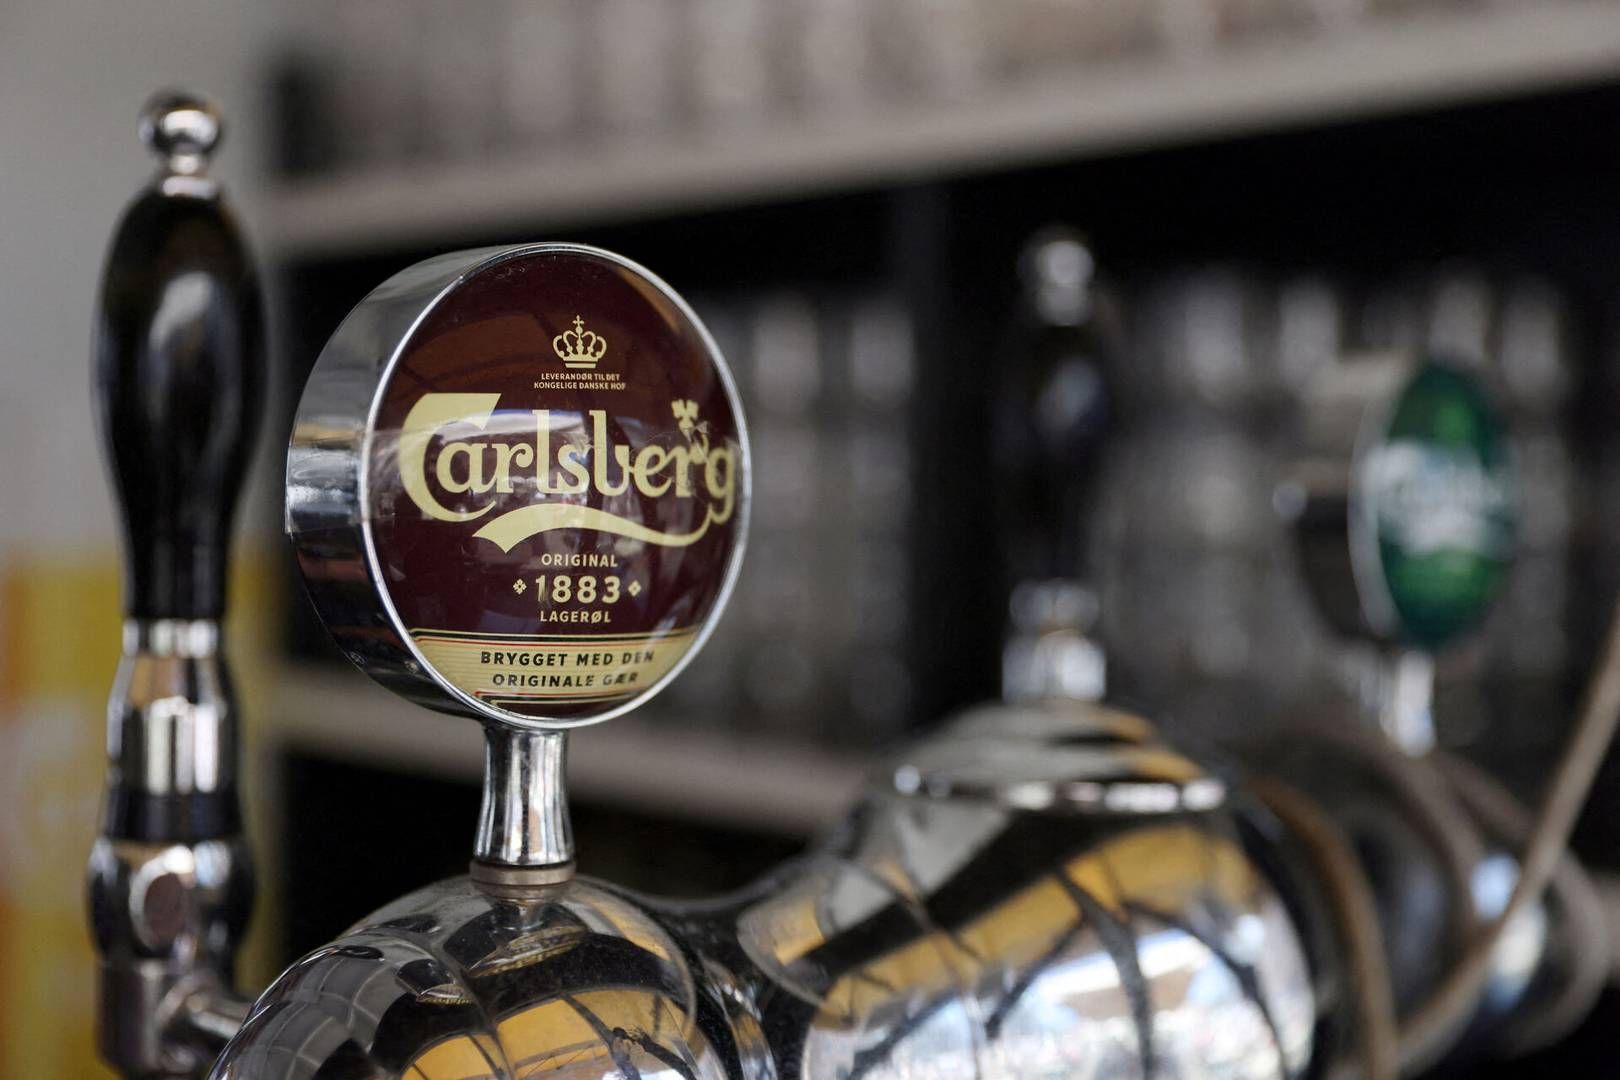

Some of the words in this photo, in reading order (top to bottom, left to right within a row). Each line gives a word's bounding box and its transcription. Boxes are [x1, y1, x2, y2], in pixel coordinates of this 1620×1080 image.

[605, 373, 620, 381] DET
[534, 382, 577, 390] KONGELIGE
[579, 382, 609, 390] DANSKE
[610, 382, 626, 390] HOF
[400, 393, 735, 524] Carlsberg
[541, 554, 618, 568] ORIGINAL
[535, 575, 621, 604] 1883
[540, 610, 612, 624] LAGERØL
[480, 651, 568, 666] BRYGGET
[576, 654, 613, 666] MED
[622, 651, 655, 664] DEN
[492, 673, 595, 687] ORIGINALE
